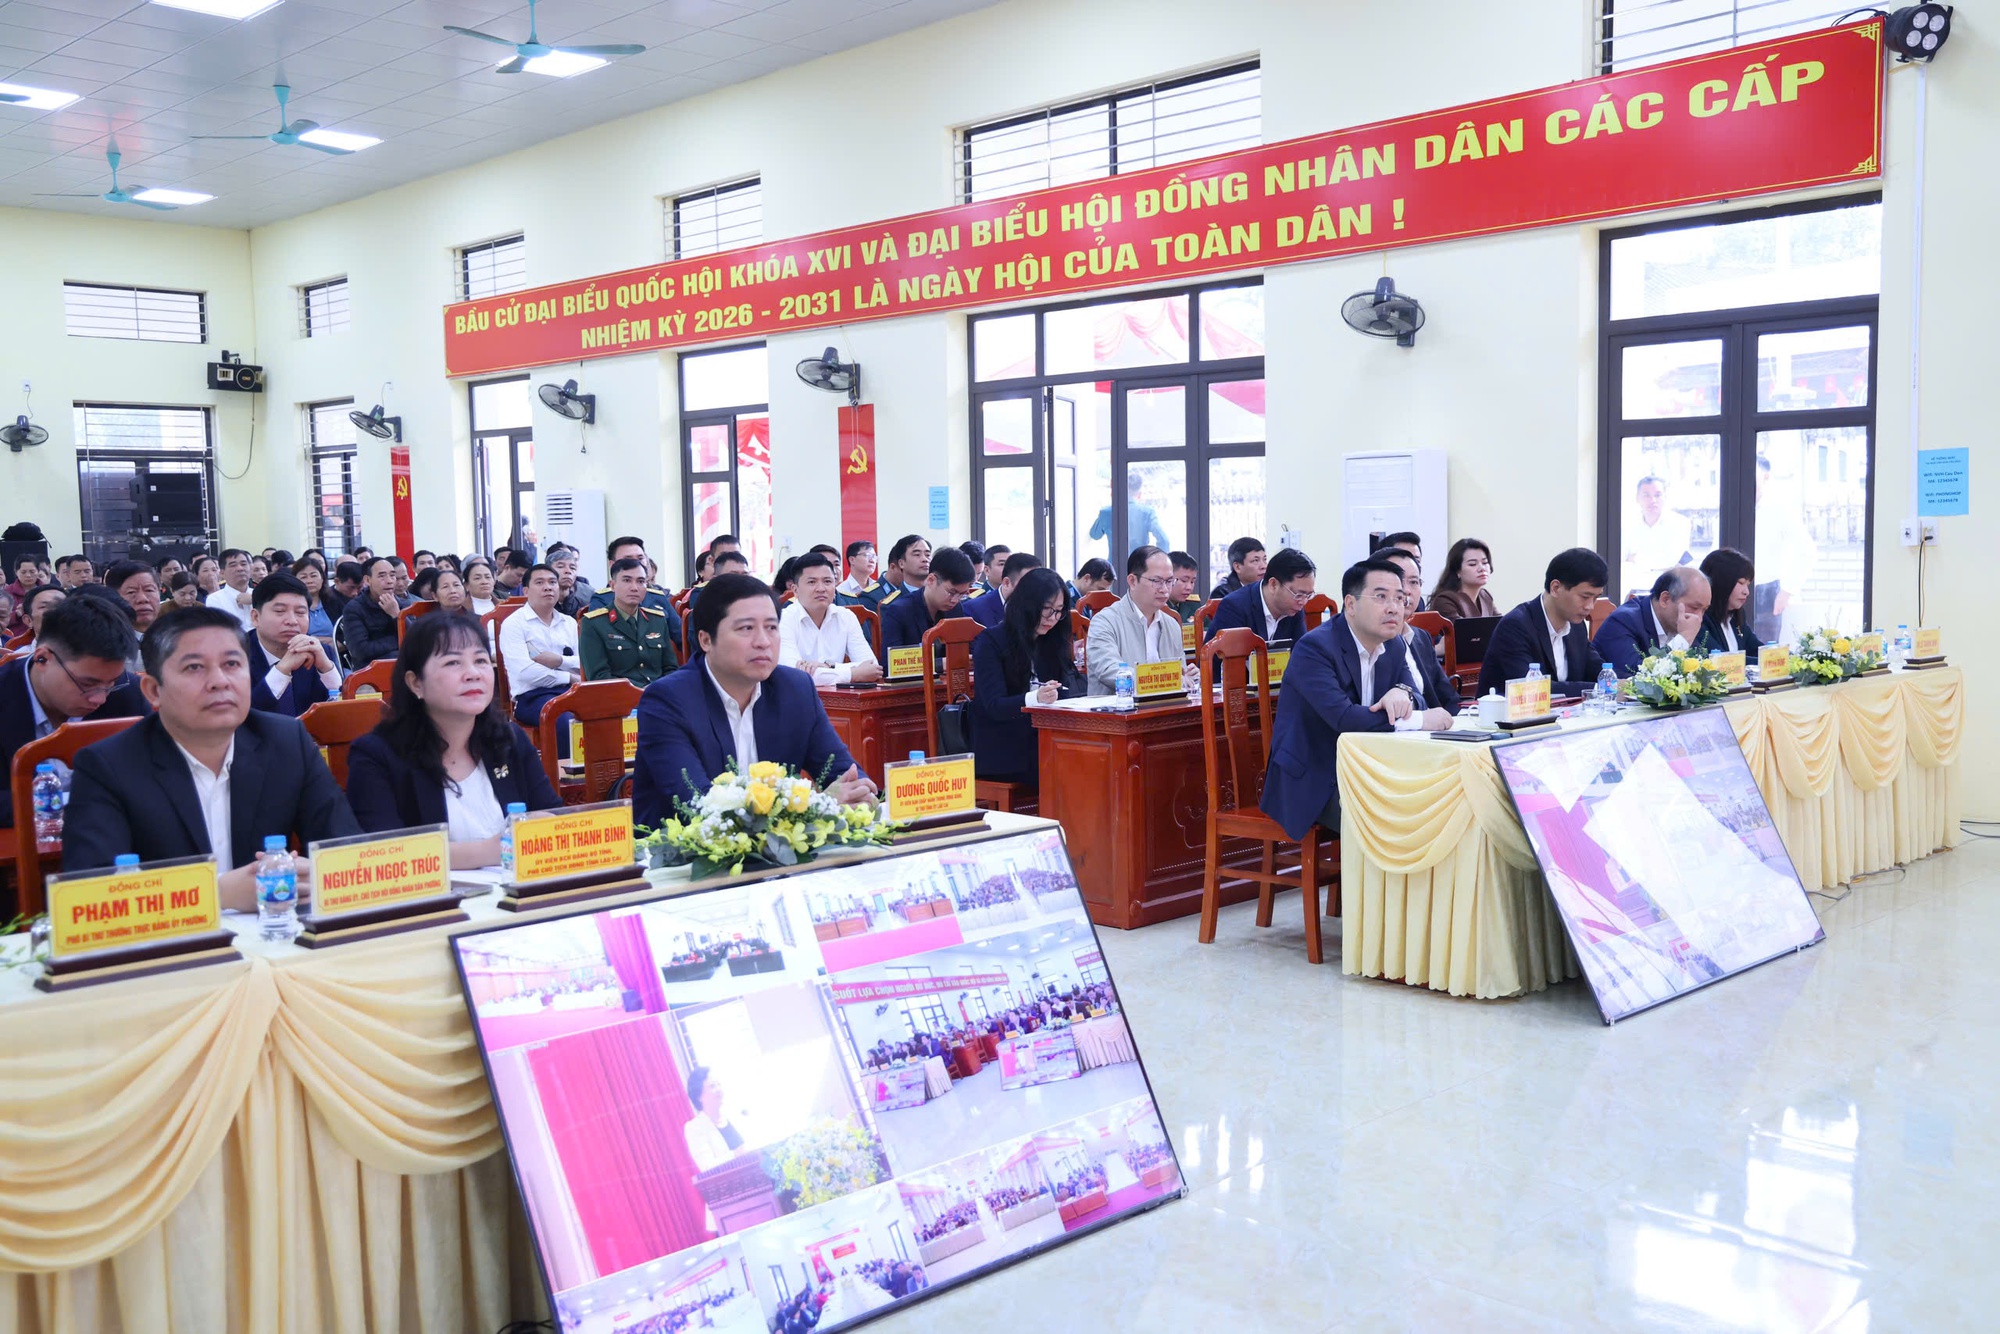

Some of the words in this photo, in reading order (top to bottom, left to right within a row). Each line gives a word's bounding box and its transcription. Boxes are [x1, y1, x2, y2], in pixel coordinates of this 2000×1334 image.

[455, 306, 490, 335] BẦU
[495, 298, 521, 328] CỬ
[525, 299, 557, 326] ĐẠI
[563, 283, 609, 317] BIỂU
[616, 271, 675, 310] QUỐC
[683, 266, 722, 299] HỘI
[731, 253, 799, 288] KHÓA
[808, 245, 852, 275] XVI
[861, 232, 898, 265] VÀ
[908, 226, 960, 259] ĐẠI
[973, 202, 1048, 248] BIỂU
[1062, 192, 1122, 228] HỘI
[1136, 172, 1249, 218] ĐỒNG
[1264, 143, 1396, 196] NHÂN
[1414, 119, 1524, 170] DÂN
[1545, 90, 1664, 145] CÁC
[1689, 53, 1825, 118] CẤP
[582, 316, 651, 349] NHIỆM
[658, 309, 687, 338] KỲ
[694, 304, 754, 333] 2026
[779, 289, 841, 321] 2031
[854, 277, 889, 310] LÀ
[899, 266, 983, 302] NGÀY
[994, 254, 1051, 292] HỘI
[1064, 236, 1140, 280] CỦA
[1151, 222, 1261, 266] TOÀN
[1276, 205, 1372, 249] DÂN
[1393, 198, 1405, 230] !
[897, 783, 925, 798] DƯƠNG
[928, 776, 949, 795] QUỐC
[952, 777, 967, 790] HUY
[359, 848, 386, 860] ĐỒNG
[521, 834, 554, 856] HOÀNG
[555, 834, 571, 853] THỊ
[573, 831, 602, 848] THANH
[604, 823, 626, 843] BÌNH
[108, 881, 141, 894] ĐỒNG
[144, 878, 163, 888] CHÍ
[323, 861, 373, 891] NGUYỄN
[375, 861, 408, 883] NGỌC
[411, 853, 440, 876] TRÚC
[72, 898, 130, 925] PHẠM
[135, 893, 165, 916] THỊ
[170, 886, 200, 910] MƠ
